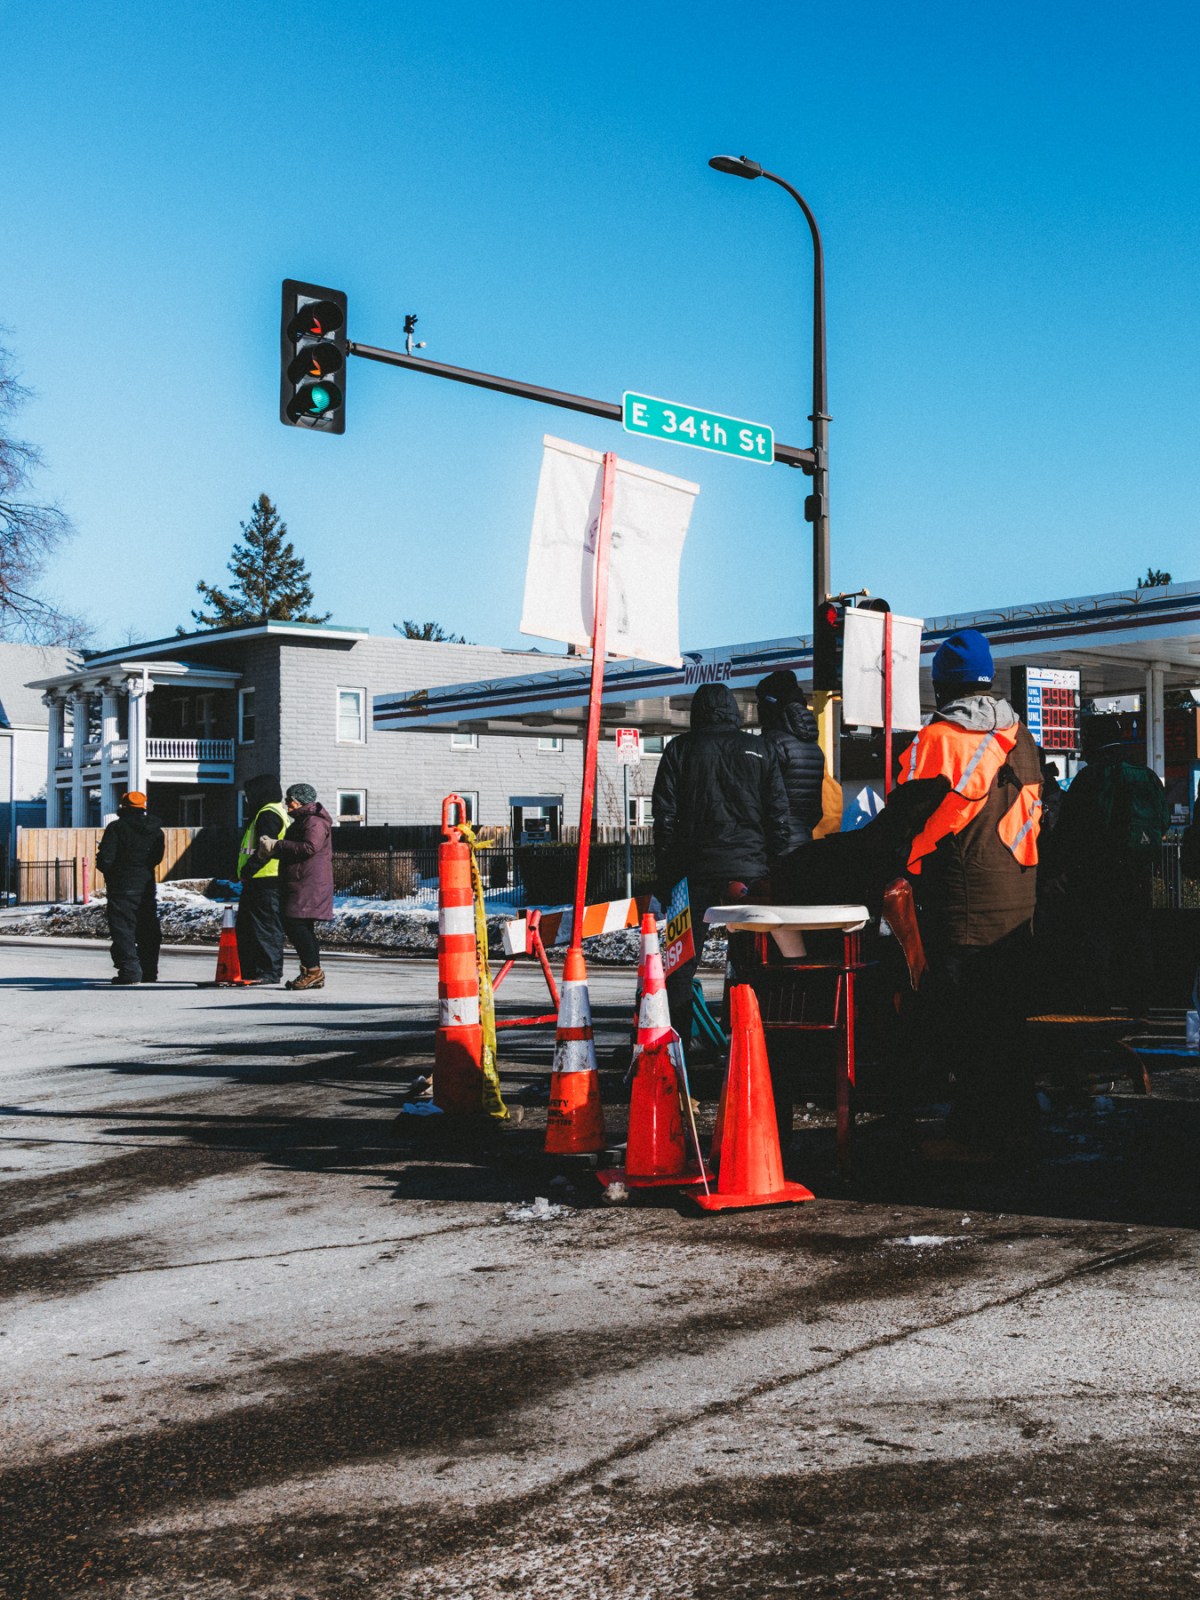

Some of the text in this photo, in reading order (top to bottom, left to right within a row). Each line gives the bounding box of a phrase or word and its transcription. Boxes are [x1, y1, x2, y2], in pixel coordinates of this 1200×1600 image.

[632, 402, 766, 455] E 34th St
[684, 662, 731, 685] WINNER
[1028, 711, 1040, 722] UNL
[667, 908, 689, 942] OUT
